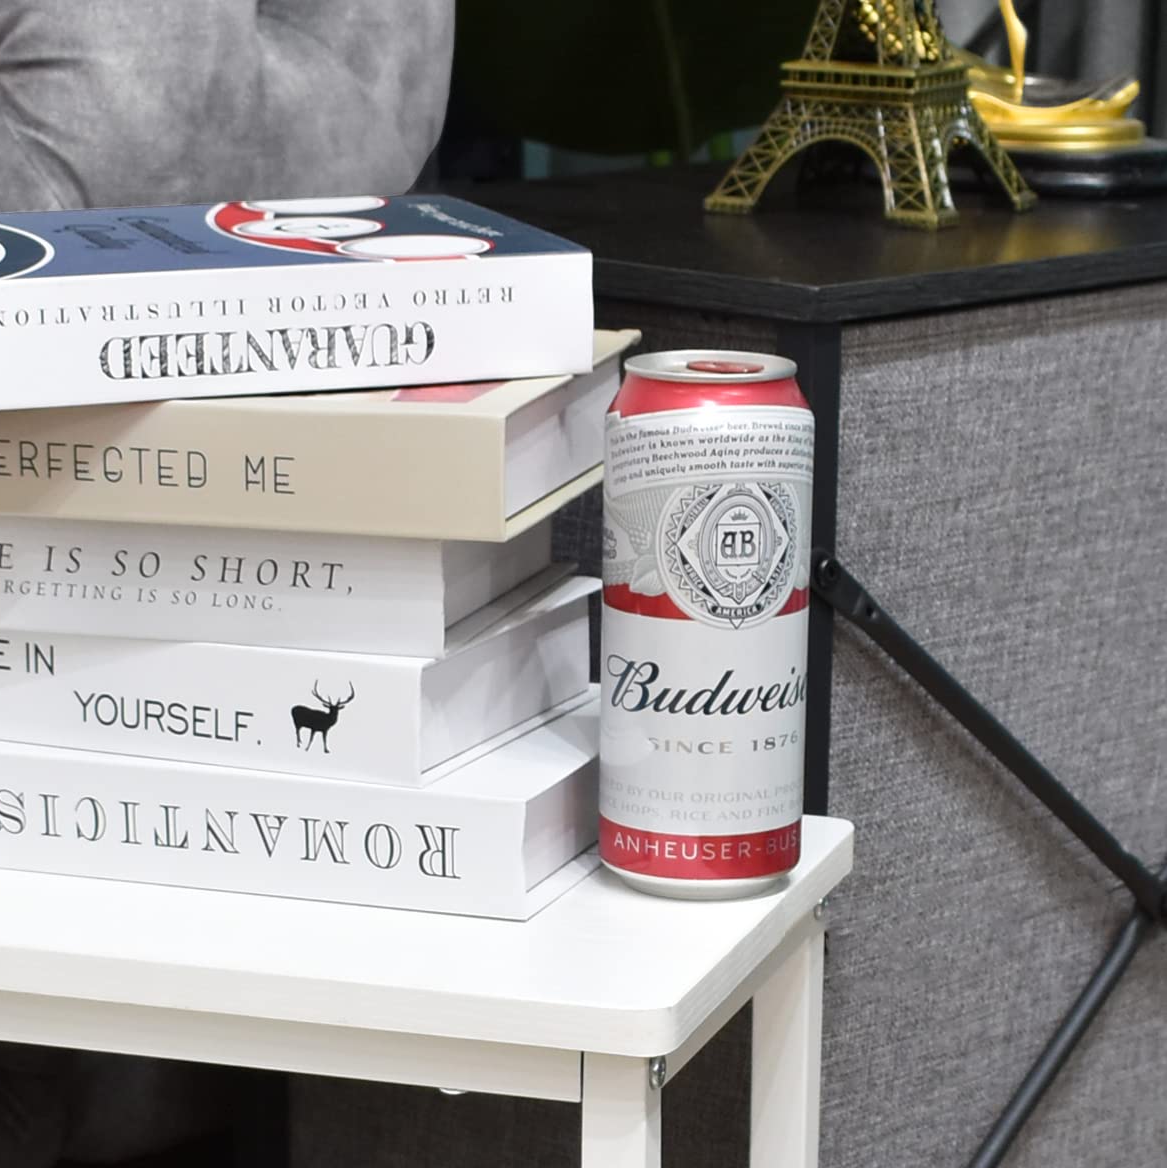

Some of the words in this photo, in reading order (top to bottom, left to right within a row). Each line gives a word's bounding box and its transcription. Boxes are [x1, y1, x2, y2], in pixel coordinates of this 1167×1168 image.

[268, 292, 390, 314] VECTOR
[412, 286, 514, 305] RETRO
[98, 319, 436, 381] GUARANTEED
[638, 429, 671, 440] famous
[648, 441, 656, 450] is
[660, 438, 694, 448] known
[698, 433, 755, 445] worldwide
[772, 433, 785, 443] the
[652, 448, 707, 463] Beechwood
[710, 447, 740, 457] Aging
[742, 445, 784, 457] produces
[244, 454, 296, 495] ME
[644, 463, 687, 477] uniquely
[688, 460, 727, 471] smooth
[729, 460, 755, 469] taste
[756, 459, 776, 469] with
[43, 545, 82, 574] IS
[110, 549, 162, 579] SO
[191, 555, 355, 596] SHORT,
[137, 587, 159, 604] IS
[171, 590, 198, 606] SO
[211, 593, 283, 613] LONG.
[25, 641, 56, 677] IN
[73, 689, 262, 746] YOURSELF.
[647, 736, 735, 755] SINCE
[750, 730, 800, 753] 1876
[648, 788, 685, 802] OUR
[690, 788, 770, 803] ORIGINAL
